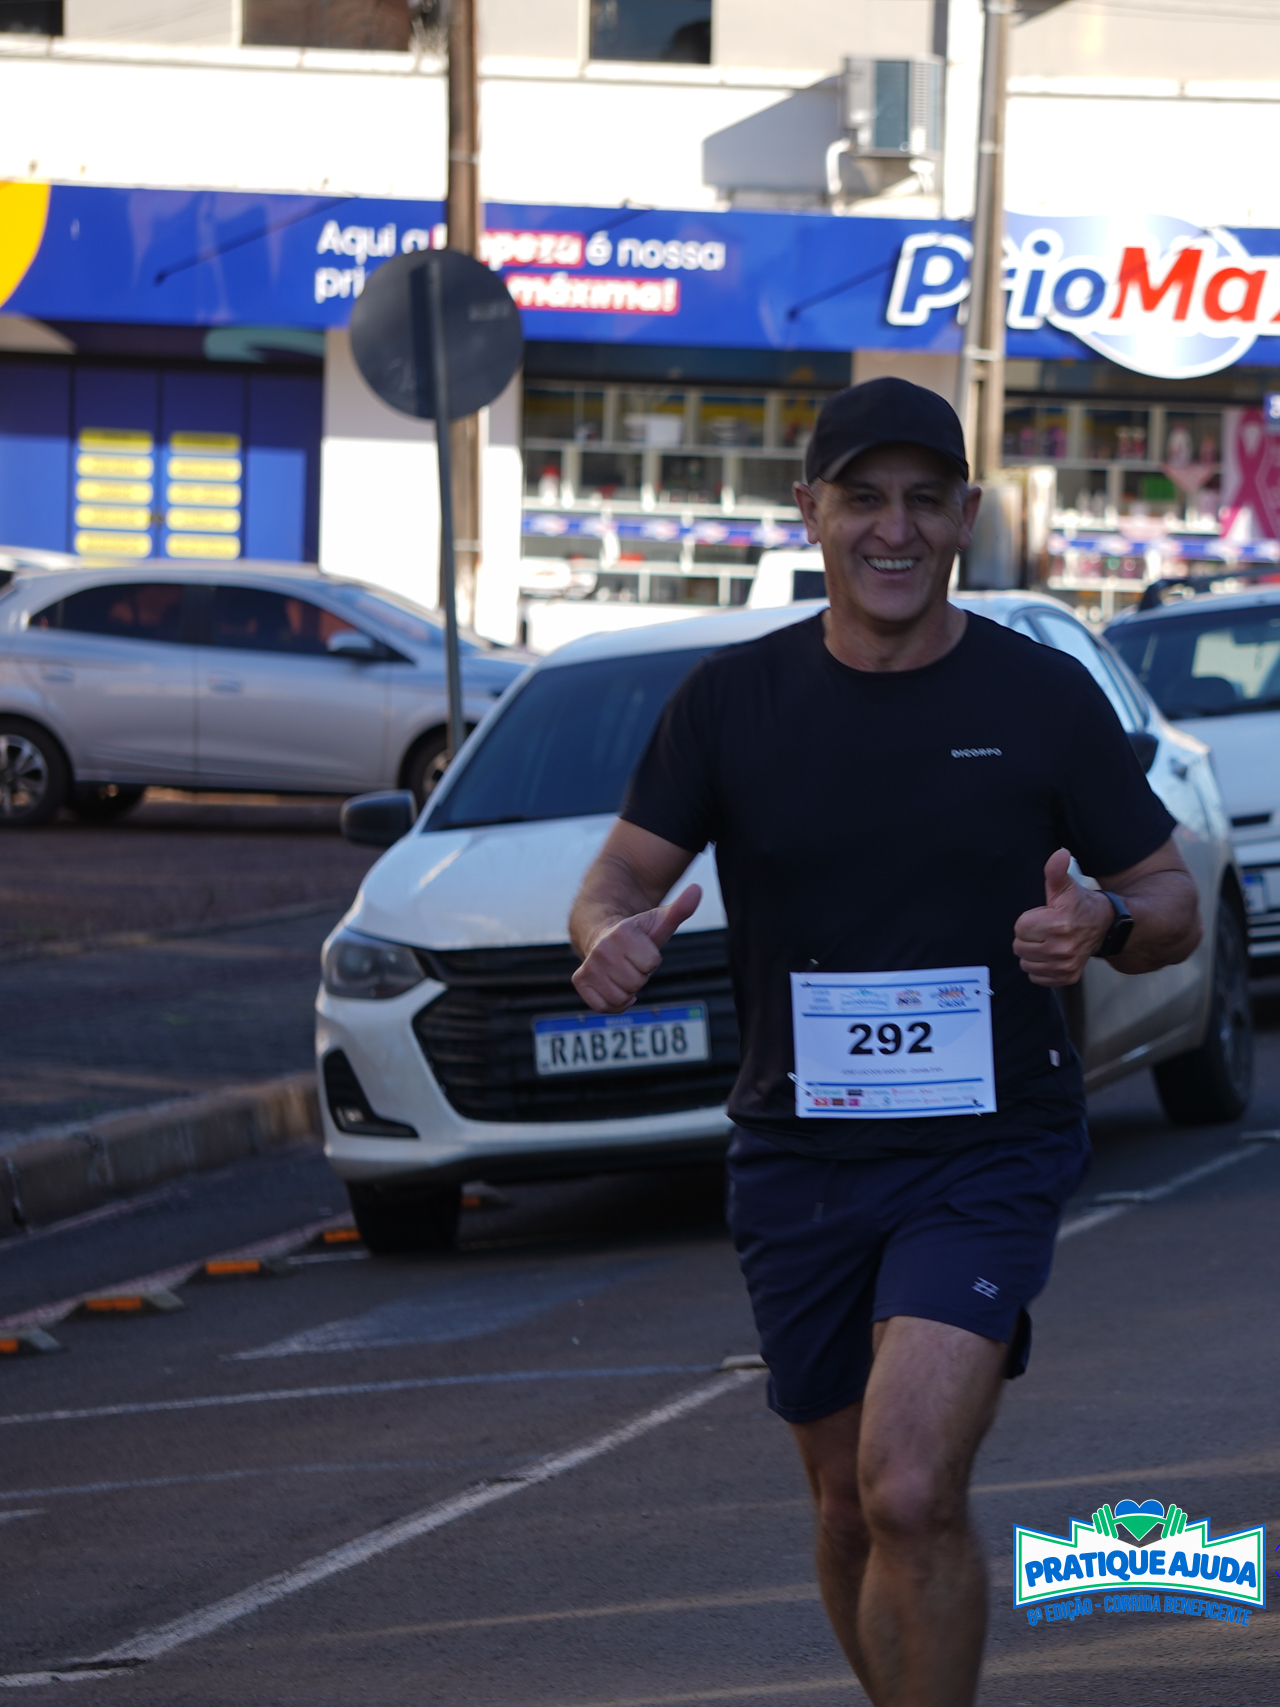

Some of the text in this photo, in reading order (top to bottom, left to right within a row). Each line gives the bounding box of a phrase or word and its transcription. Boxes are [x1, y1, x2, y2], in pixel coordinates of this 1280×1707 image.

[317, 220, 396, 264] Aqui
[586, 232, 613, 266] é
[617, 238, 726, 271] nossa
[551, 1025, 688, 1066] RAB2E08
[848, 1021, 934, 1056] 292
